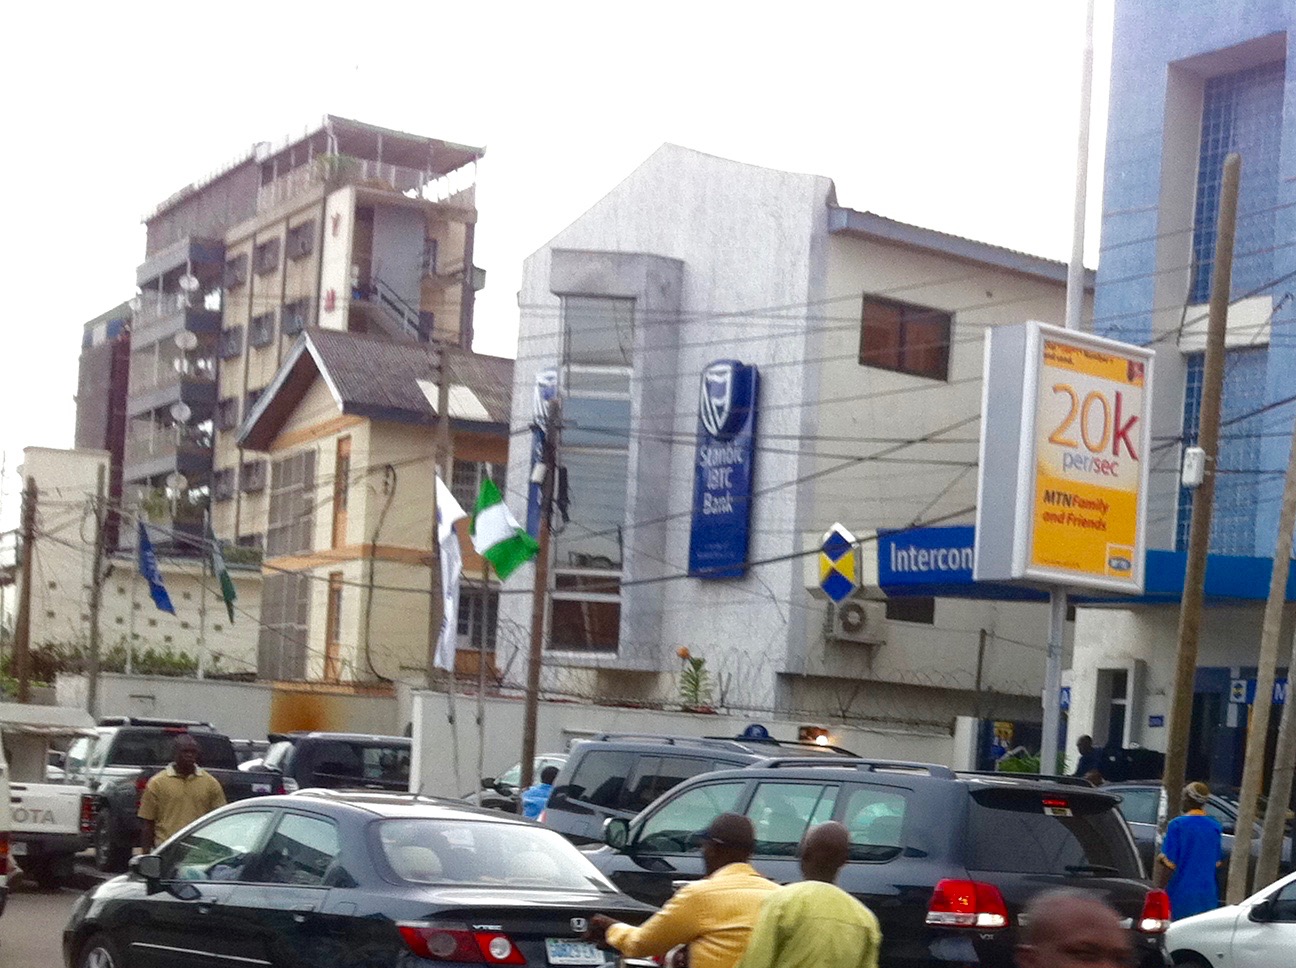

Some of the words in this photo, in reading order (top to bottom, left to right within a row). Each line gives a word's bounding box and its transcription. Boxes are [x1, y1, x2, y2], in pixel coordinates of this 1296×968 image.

[1048, 383, 1139, 461] 20k
[702, 491, 734, 515] Bank
[1043, 511, 1066, 525] and
[1067, 511, 1107, 533] Friends
[890, 542, 974, 572] Intercon
[12, 808, 57, 824] OTA
